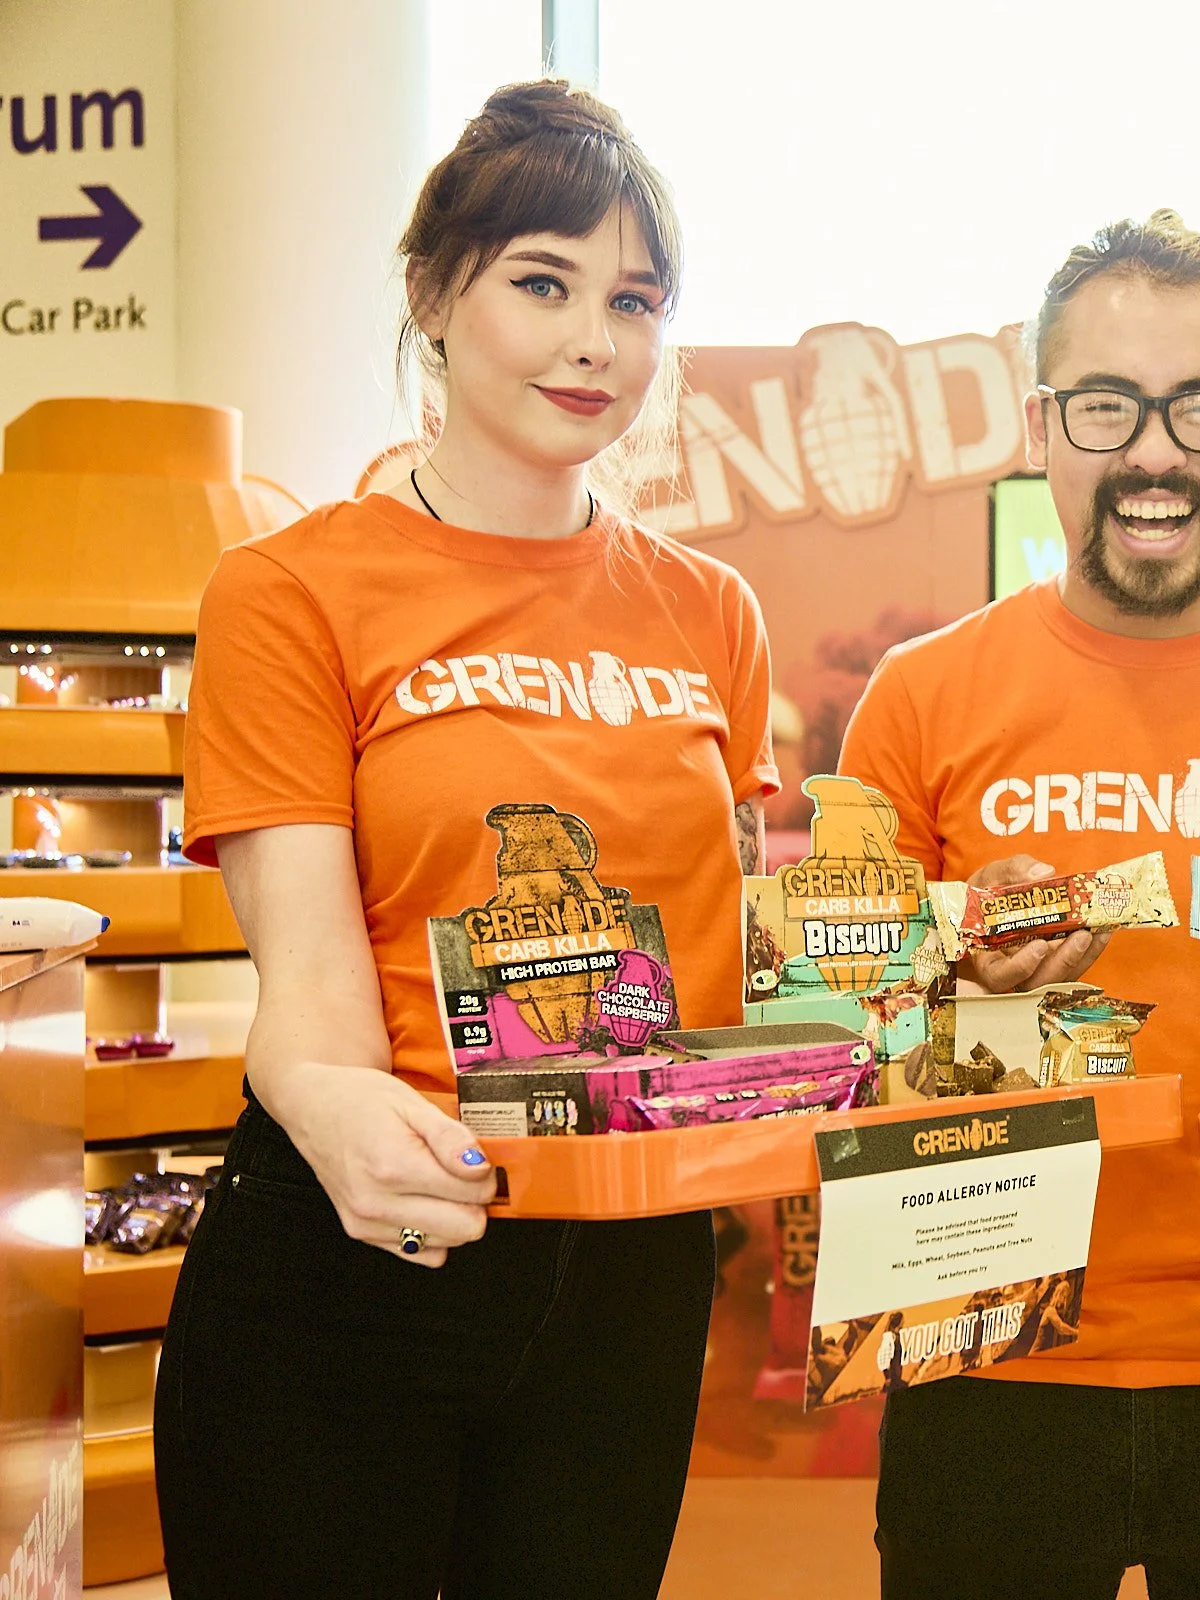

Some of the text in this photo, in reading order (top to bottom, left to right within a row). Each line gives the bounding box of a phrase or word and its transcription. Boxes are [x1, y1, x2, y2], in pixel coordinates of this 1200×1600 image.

[0, 88, 145, 155] um
[1, 293, 147, 336] Car Park
[395, 651, 721, 727] GRENADE
[784, 861, 917, 898] GRENADE
[805, 896, 901, 916] CARB KILLA
[980, 886, 1070, 916] GRENADE
[996, 903, 1058, 924] CARB KILLA
[464, 896, 628, 943] GRENADE
[1016, 917, 1045, 929] PROTEIN
[1045, 914, 1060, 924] BAR
[494, 932, 612, 963] CARB KILLA
[500, 953, 617, 981] HIGH PROTEIN BAR
[459, 995, 479, 1007] 20g
[597, 990, 670, 1013] CHOCOLATE
[618, 982, 651, 998] DARK
[601, 1002, 669, 1024] RASPBERRY
[464, 1026, 487, 1039] 0.9g
[913, 1117, 1009, 1157] GRENADE
[901, 1174, 1037, 1209] FOOD ALLERGY NOTICE
[915, 1227, 935, 1236] Please
[945, 1220, 967, 1230] advised
[967, 1218, 979, 1226] that
[980, 1215, 992, 1224] food
[993, 1211, 1018, 1224] prepared
[916, 1238, 930, 1246] here
[931, 1236, 943, 1245] may
[944, 1231, 965, 1240] contain
[966, 1228, 981, 1236] these
[972, 1245, 995, 1254] Peanuts
[996, 1242, 1006, 1250] and
[1007, 1239, 1019, 1247] Tree
[1020, 1236, 1033, 1245] Nuts
[937, 1273, 948, 1281] Ask
[949, 1270, 967, 1278] before
[979, 1265, 988, 1274] try
[899, 1302, 1025, 1366] YOU GOT THIS
